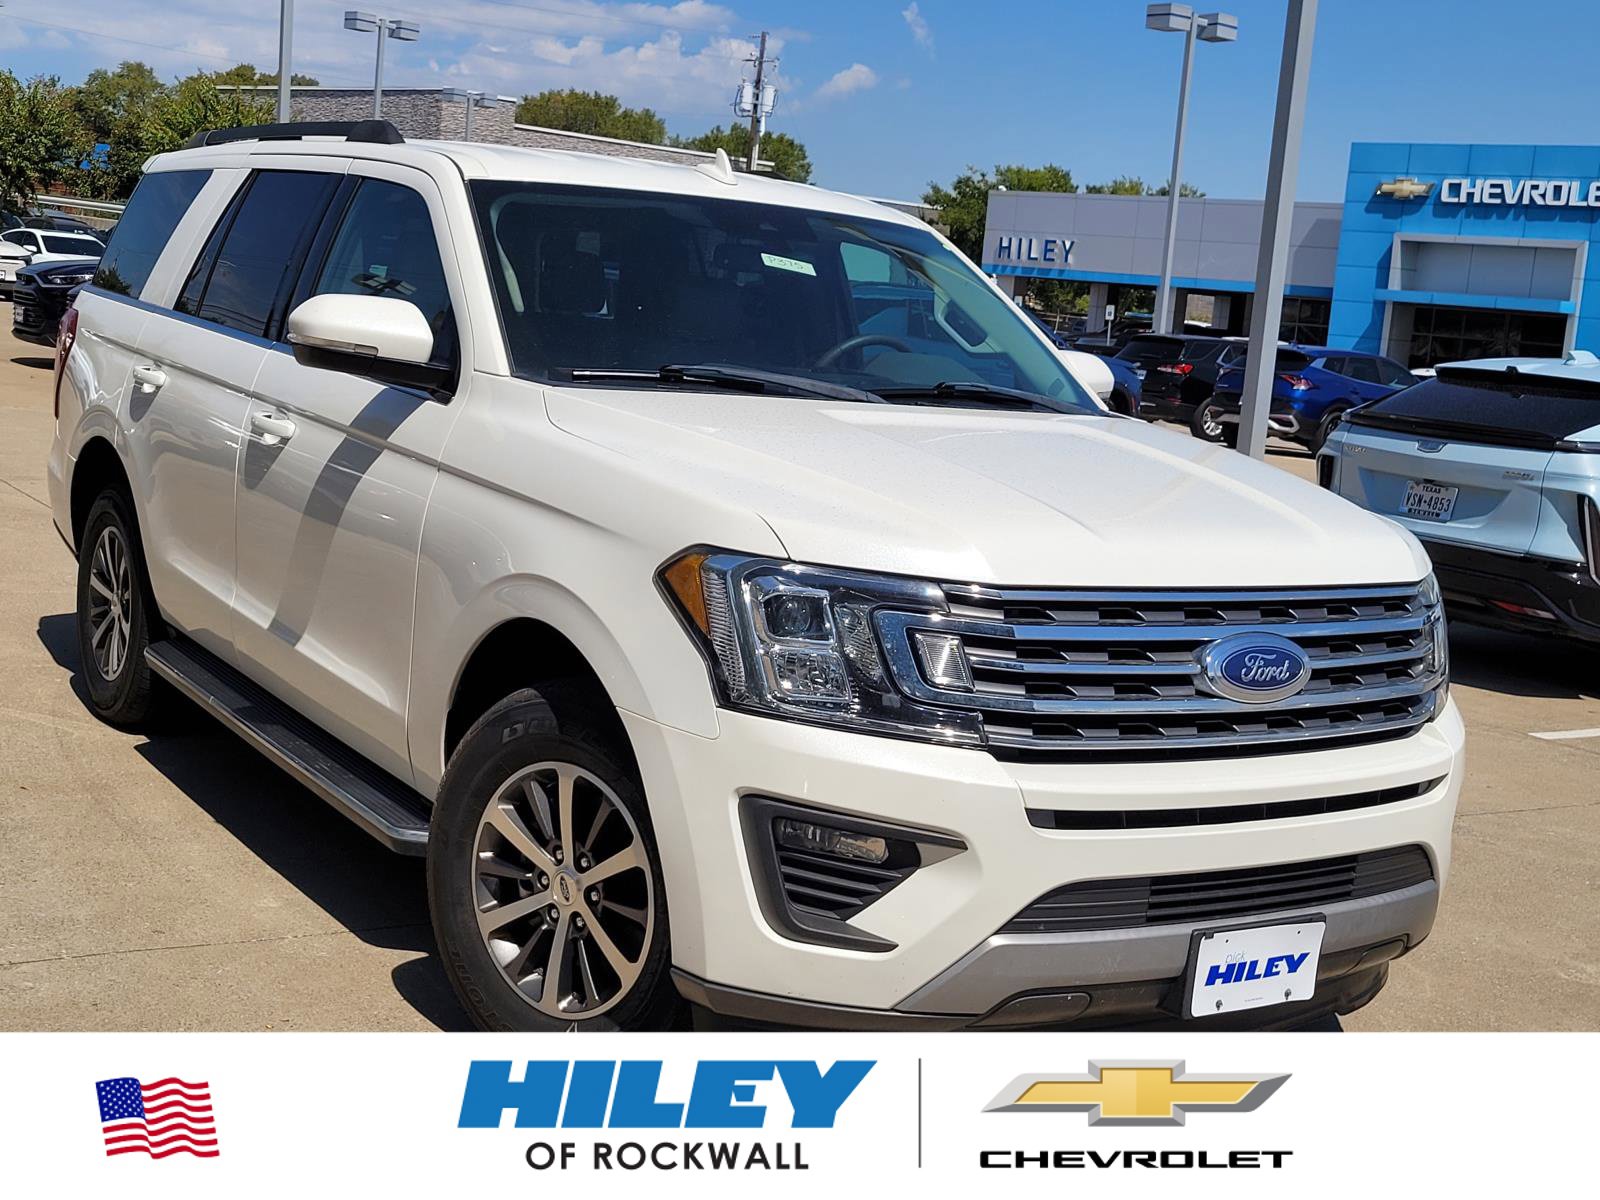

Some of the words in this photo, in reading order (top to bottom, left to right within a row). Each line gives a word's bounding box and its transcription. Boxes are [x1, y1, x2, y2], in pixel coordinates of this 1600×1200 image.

[998, 236, 1075, 263] HILEY
[1422, 485, 1441, 494] TEXAS
[1241, 653, 1290, 682] Ford
[1204, 952, 1311, 987] HILEY
